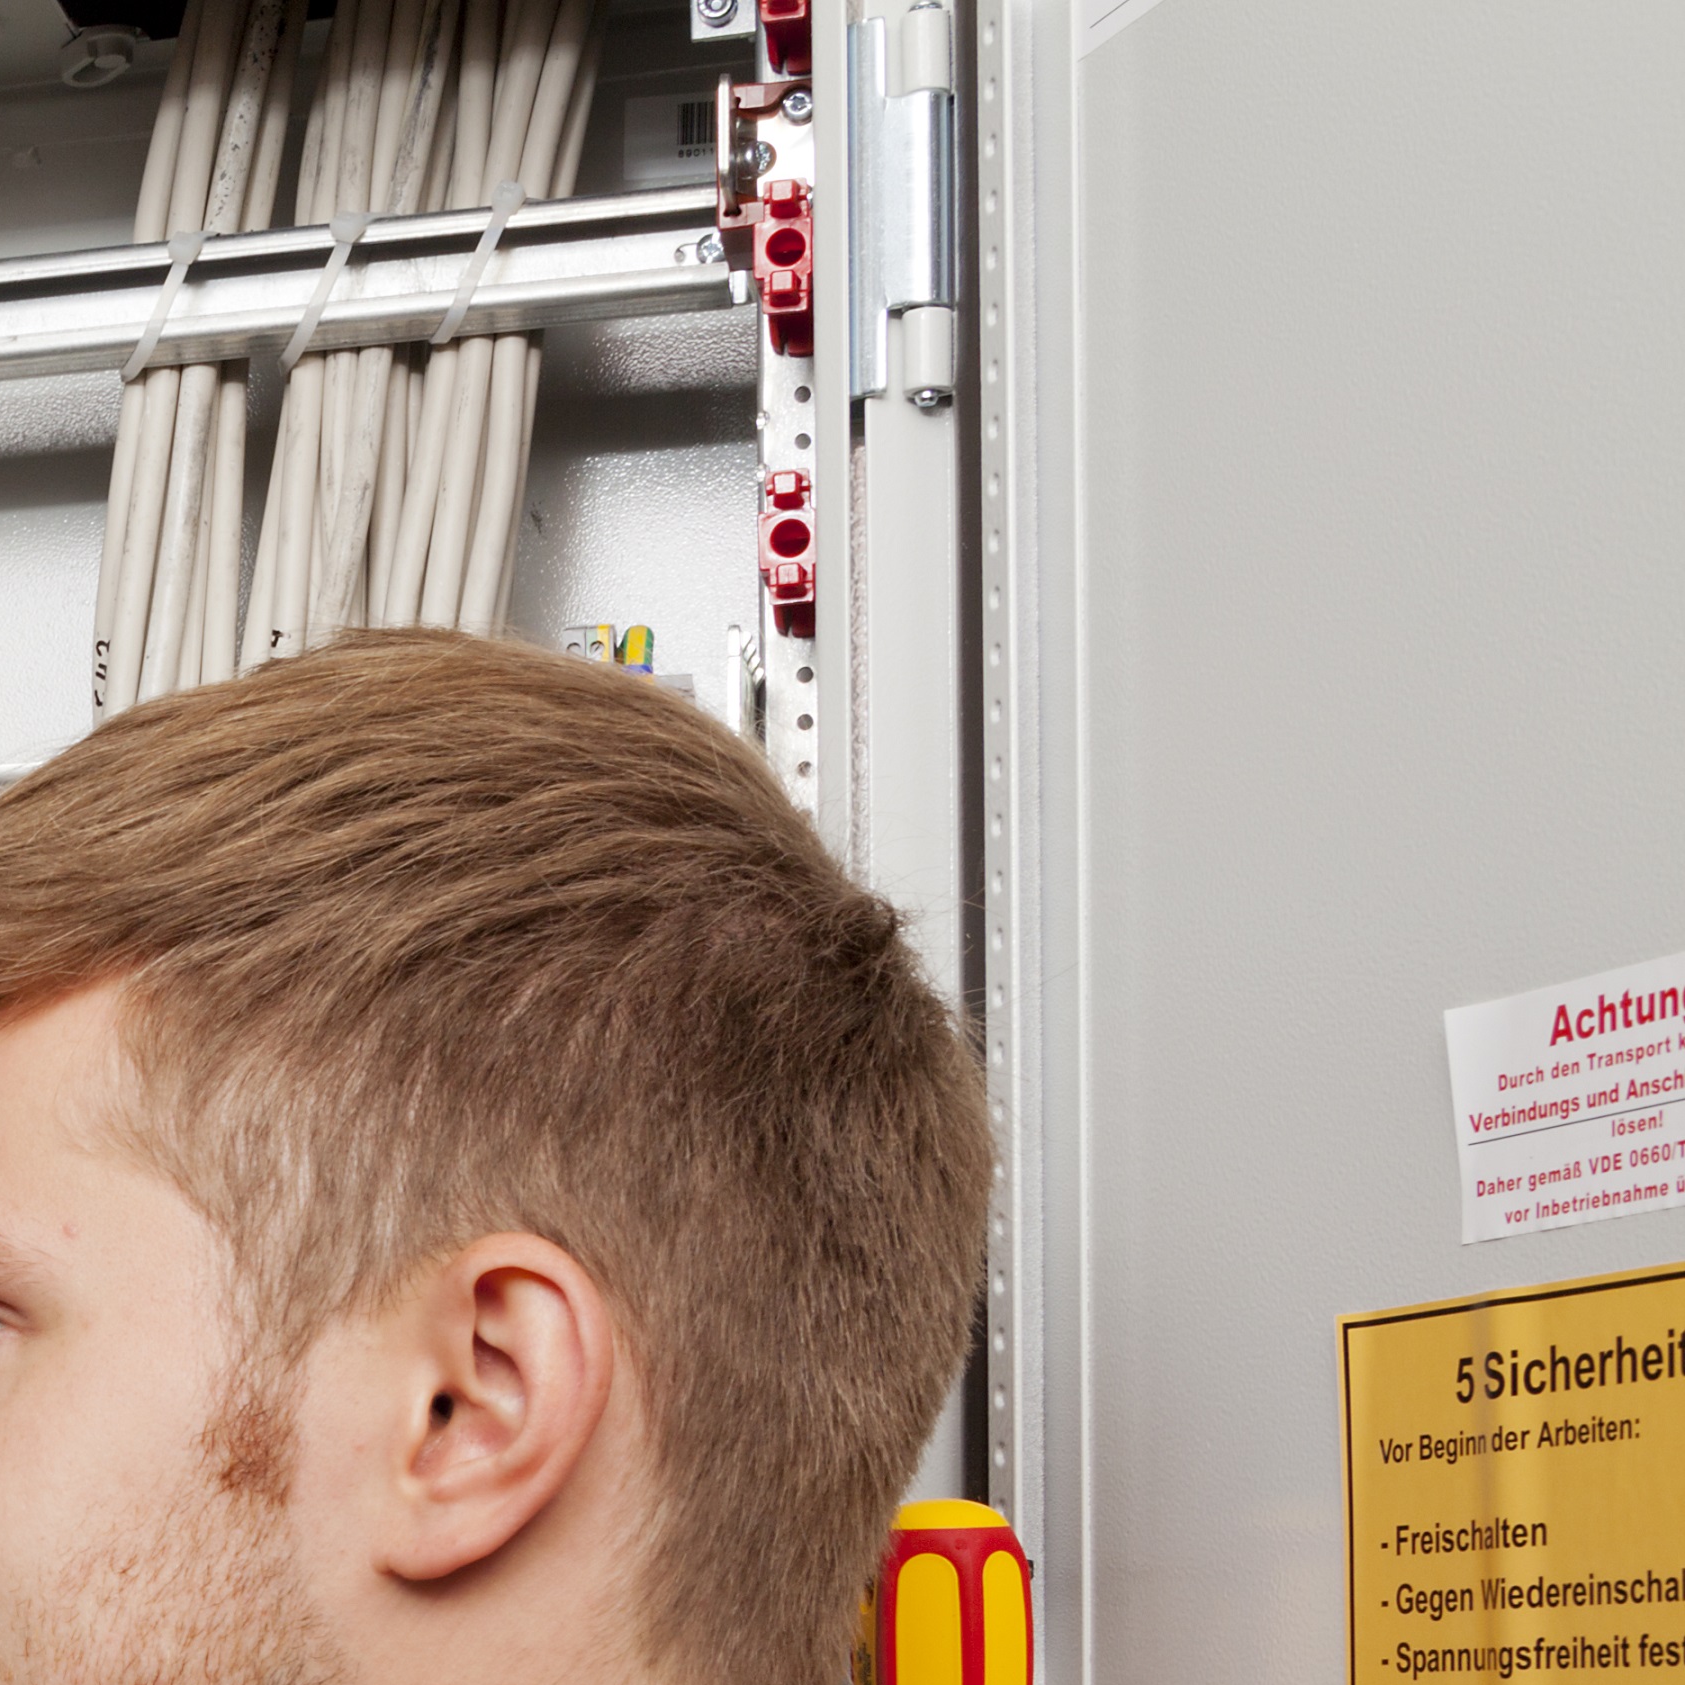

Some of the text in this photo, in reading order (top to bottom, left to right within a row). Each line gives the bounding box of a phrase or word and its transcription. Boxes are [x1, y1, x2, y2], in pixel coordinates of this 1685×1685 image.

[1549, 985, 1685, 1047] Achtun
[1498, 1066, 1544, 1091] Durch
[1551, 1061, 1580, 1079] den
[1587, 1034, 1671, 1071] Transport
[1469, 1069, 1685, 1133] Verbindungs und Ansch
[1611, 1110, 1664, 1137] lösen!
[1476, 1176, 1522, 1198] Daher
[1528, 1161, 1582, 1191] gemäß
[1589, 1152, 1623, 1175] VDE
[1505, 1207, 1530, 1224] vor
[1536, 1180, 1669, 1219] Inbetriebnahme
[1456, 1356, 1475, 1404] 5
[1379, 1416, 1641, 1465] Vor Beginn der Arbeiten:
[1396, 1517, 1548, 1556] Freischalten
[1396, 1583, 1473, 1621] Gegen
[1396, 1634, 1630, 1681] Spannungsfreiheit
